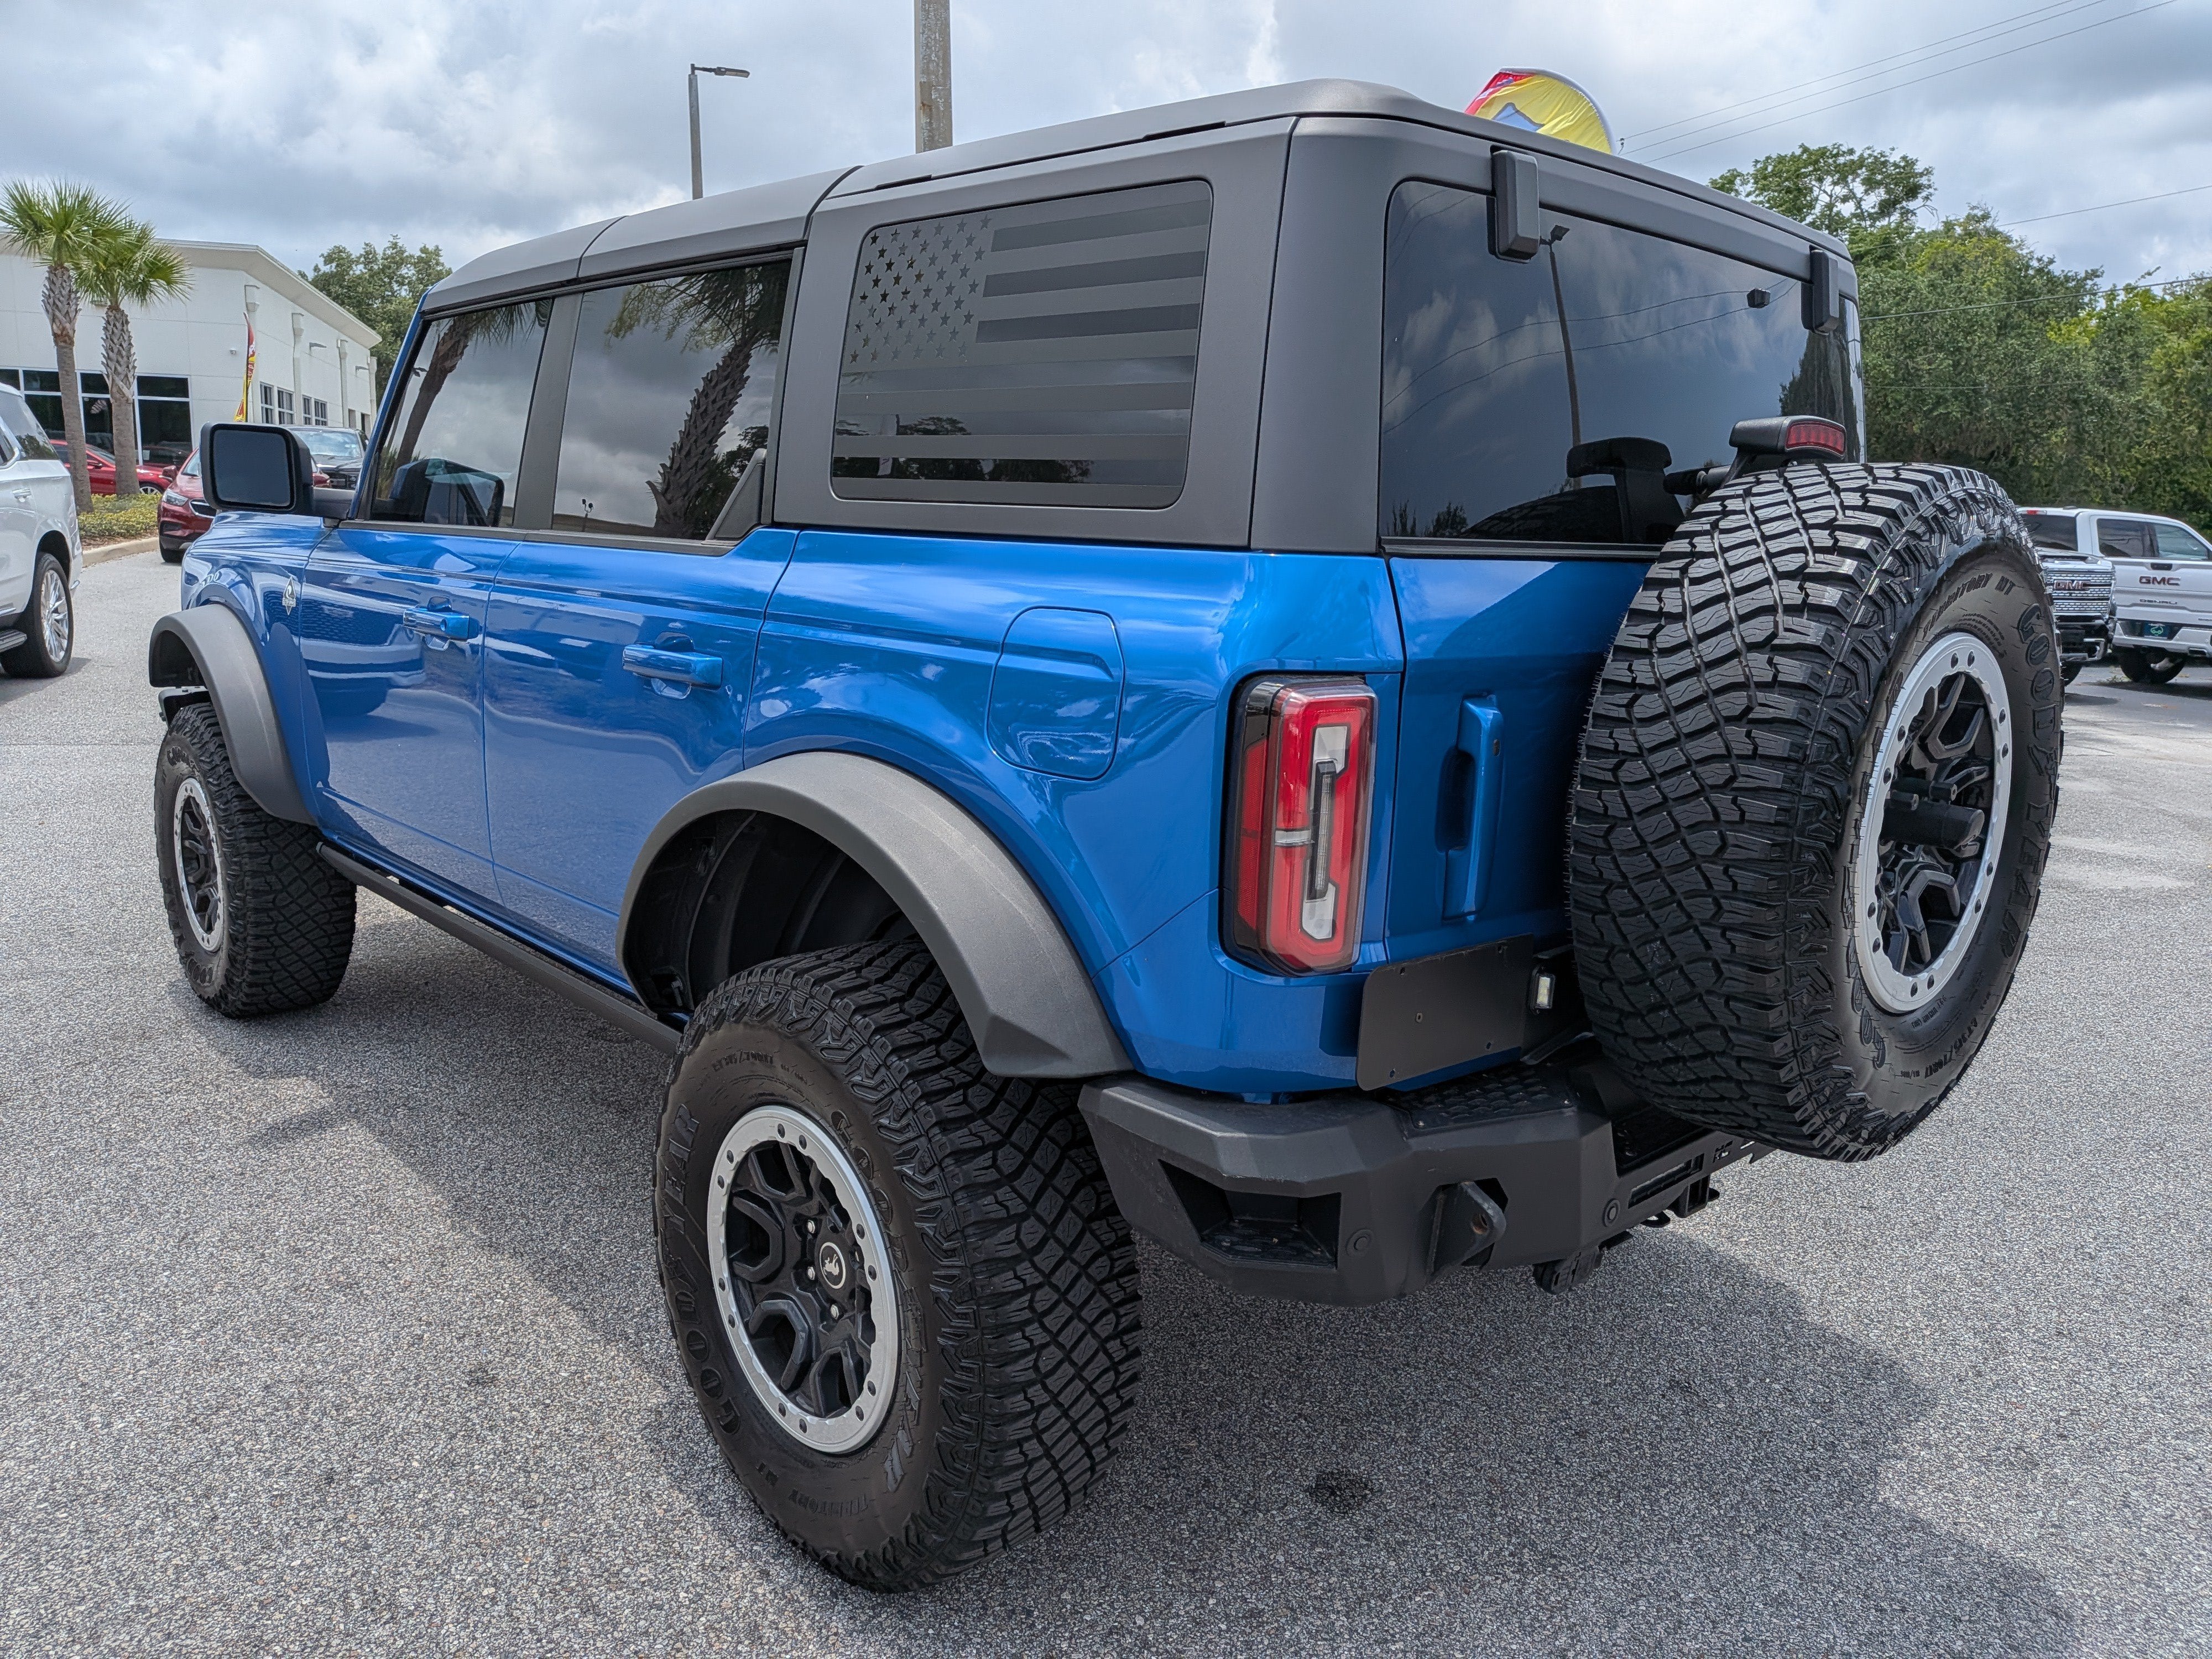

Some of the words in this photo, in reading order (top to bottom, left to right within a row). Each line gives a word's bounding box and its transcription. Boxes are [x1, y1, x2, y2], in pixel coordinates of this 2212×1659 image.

[2054, 580, 2091, 590] GMC
[2139, 576, 2181, 586] GMC
[661, 1102, 741, 1436] GOODYEAR
